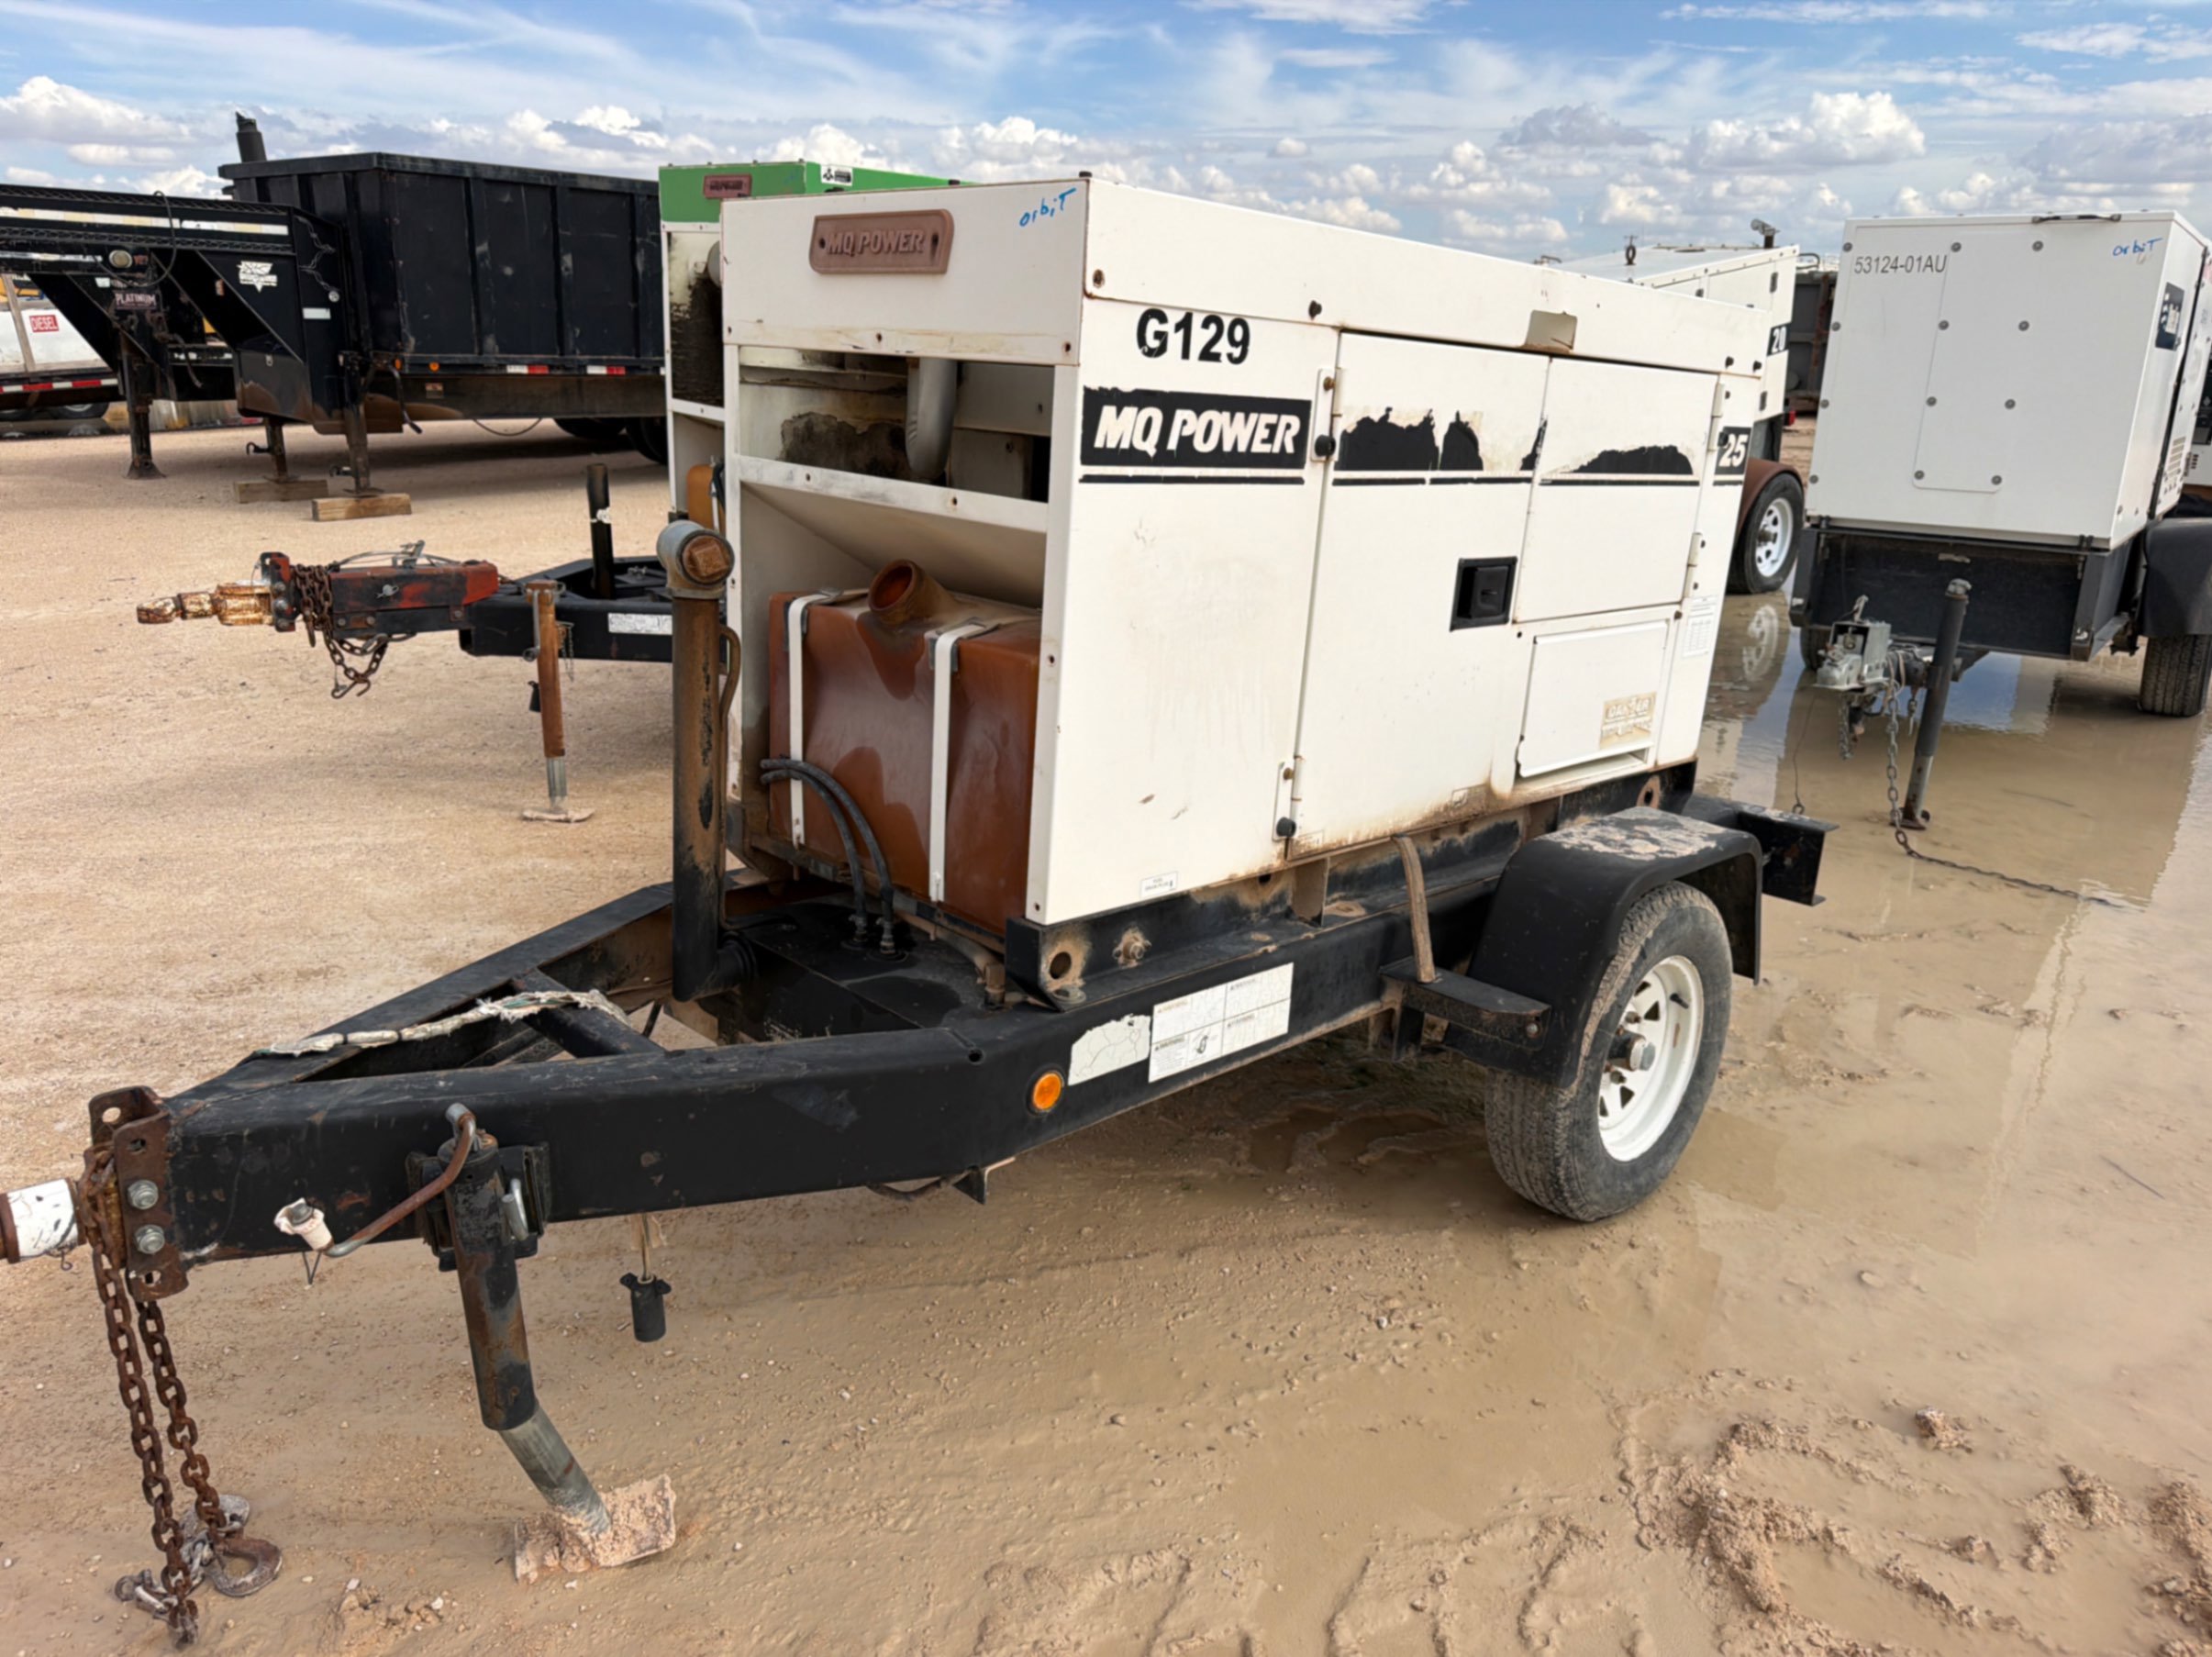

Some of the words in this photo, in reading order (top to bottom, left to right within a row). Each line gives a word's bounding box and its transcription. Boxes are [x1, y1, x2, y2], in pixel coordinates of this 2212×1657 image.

[828, 231, 855, 257] MQ
[858, 229, 925, 255] POWER
[1853, 254, 1948, 274] 53124-01AU
[1136, 307, 1251, 365] G129
[1771, 326, 1787, 353] 20
[1093, 404, 1163, 459] MQ
[1166, 408, 1301, 454] POWER
[1717, 433, 1749, 468] 25
